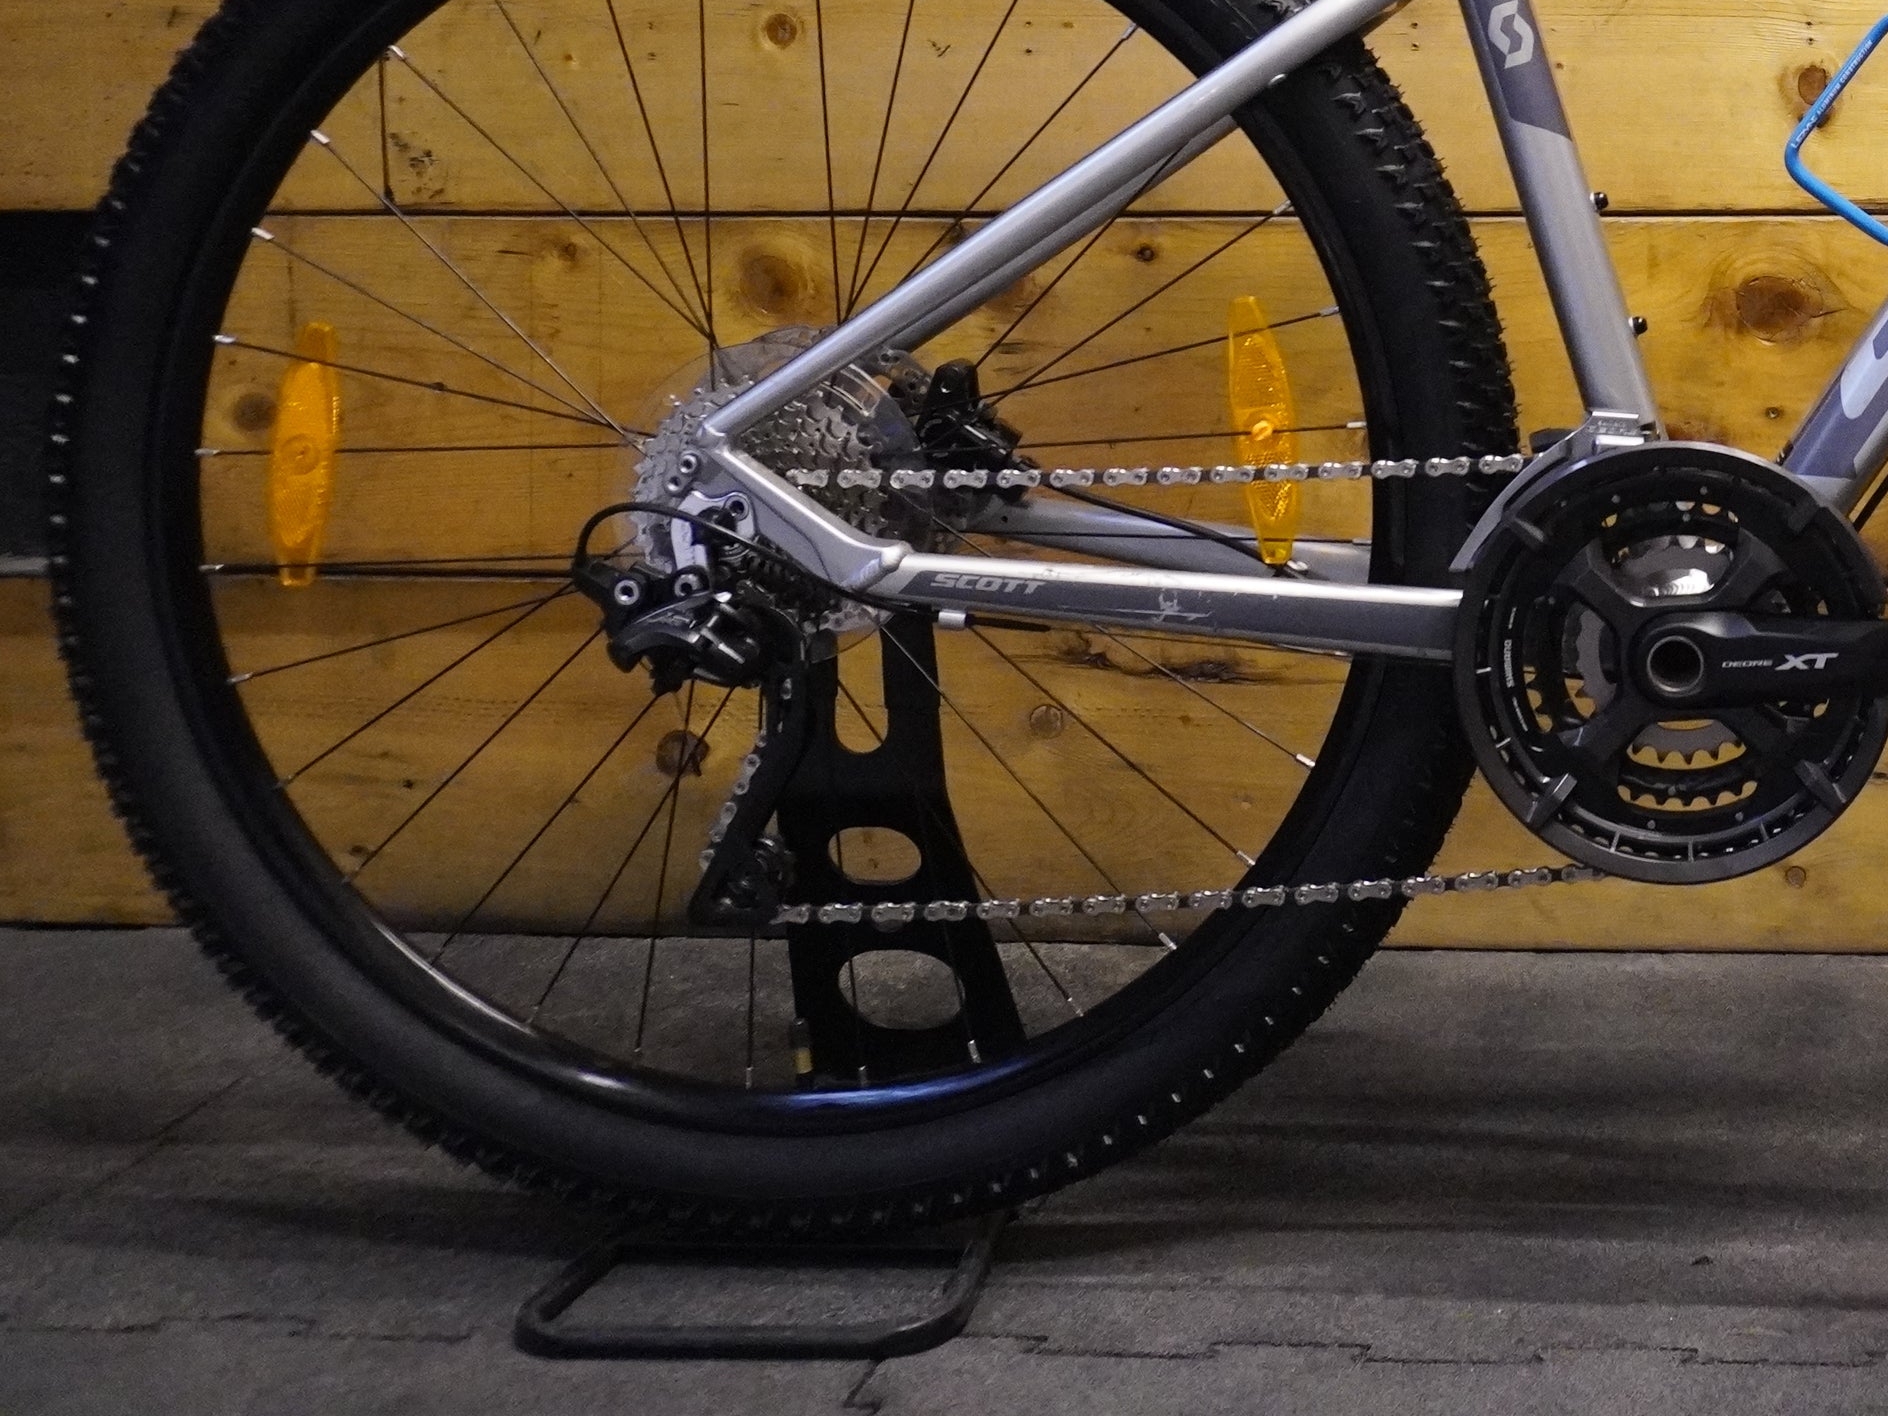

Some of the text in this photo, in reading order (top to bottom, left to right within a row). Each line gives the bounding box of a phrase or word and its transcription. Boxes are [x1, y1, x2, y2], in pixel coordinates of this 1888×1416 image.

[930, 573, 1046, 595] SCOTT
[1721, 652, 1839, 671] DEORE XT
